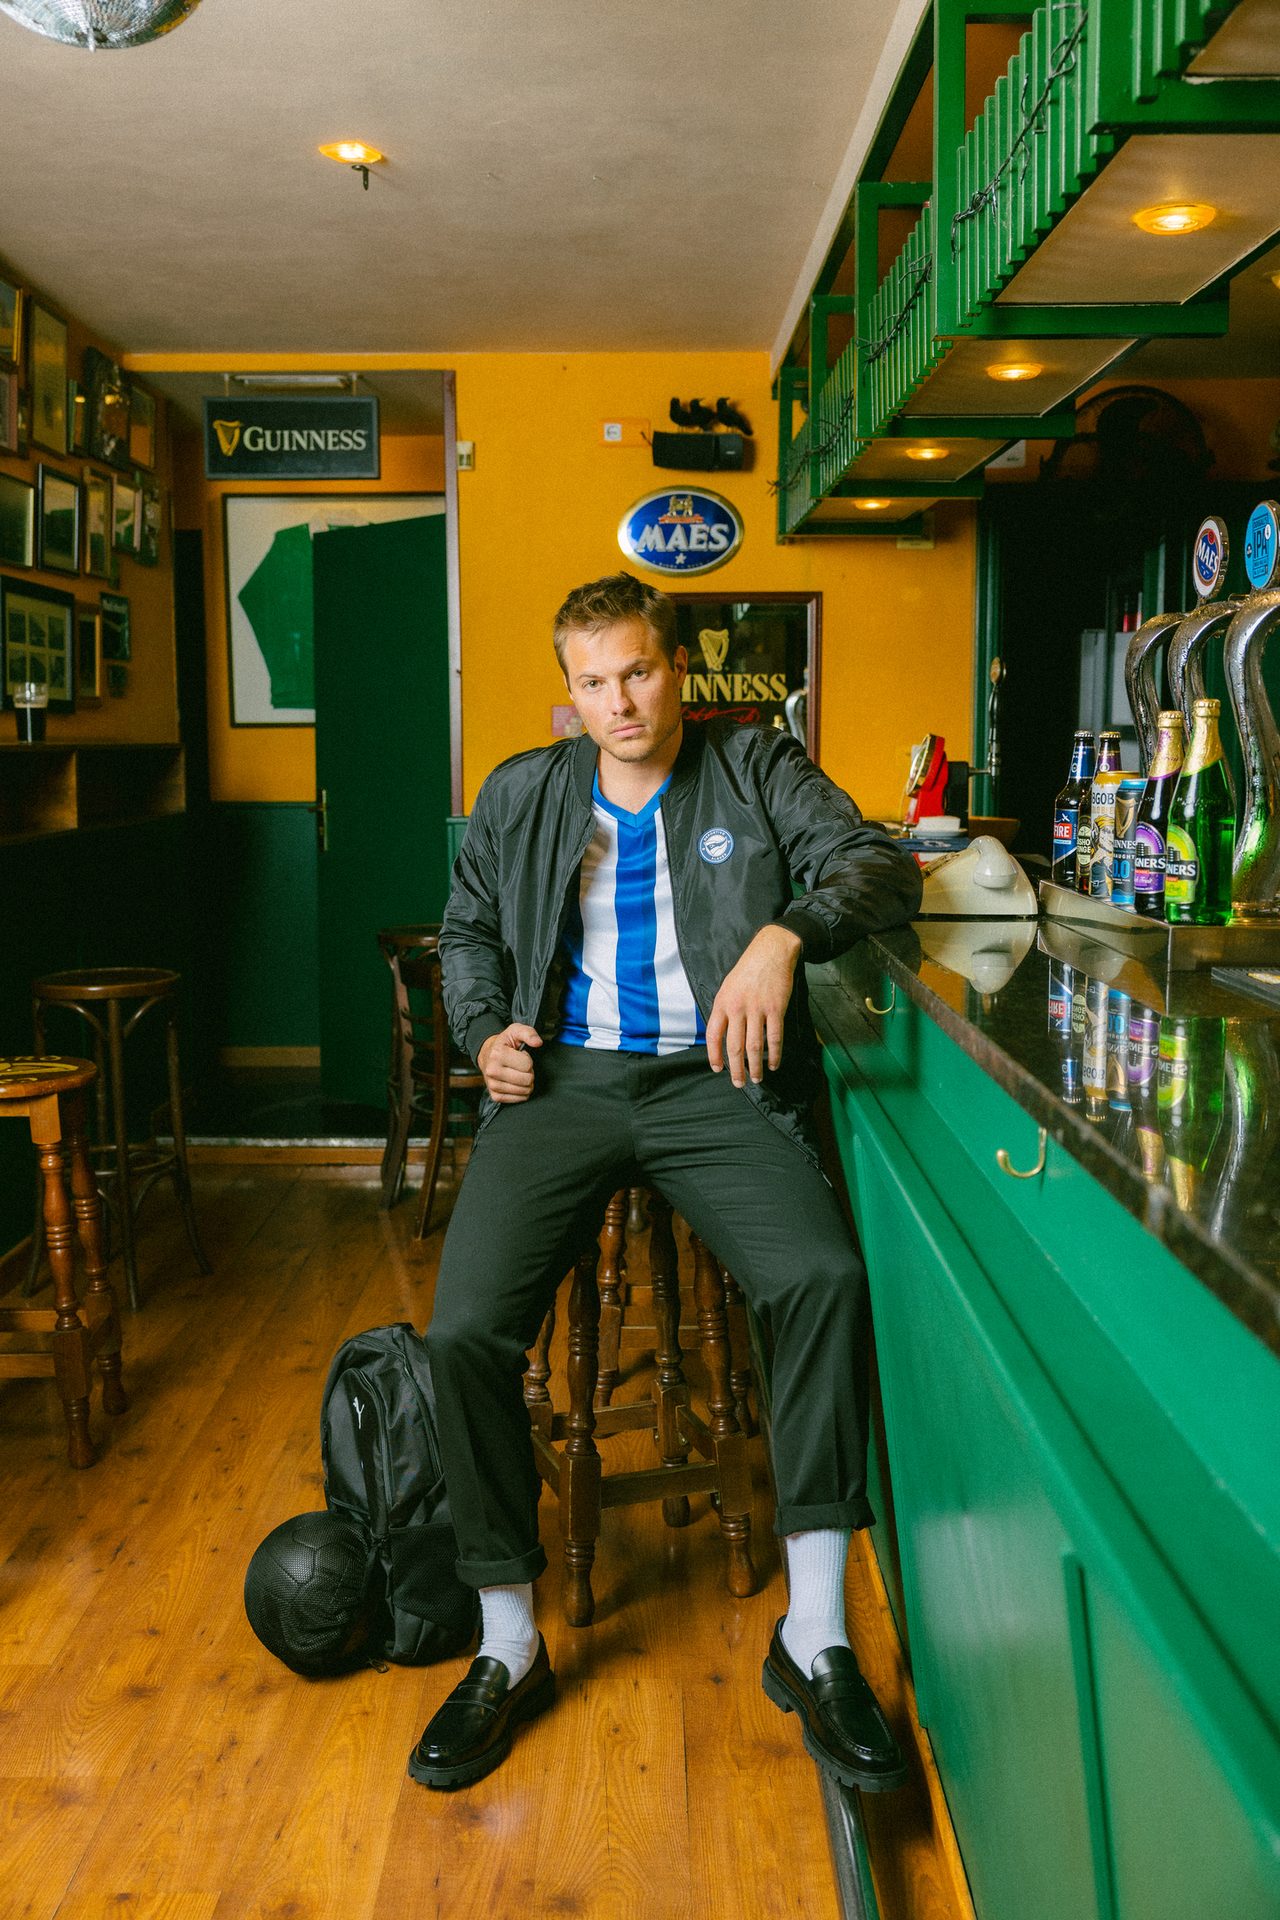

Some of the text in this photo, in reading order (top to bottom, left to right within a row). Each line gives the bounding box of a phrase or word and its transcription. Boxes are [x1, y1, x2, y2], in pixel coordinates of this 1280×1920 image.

[243, 426, 367, 451] GUINNESS
[636, 523, 730, 552] MAES
[1253, 527, 1268, 559] IPA
[1197, 539, 1219, 573] MAES
[681, 673, 788, 702] INNESS
